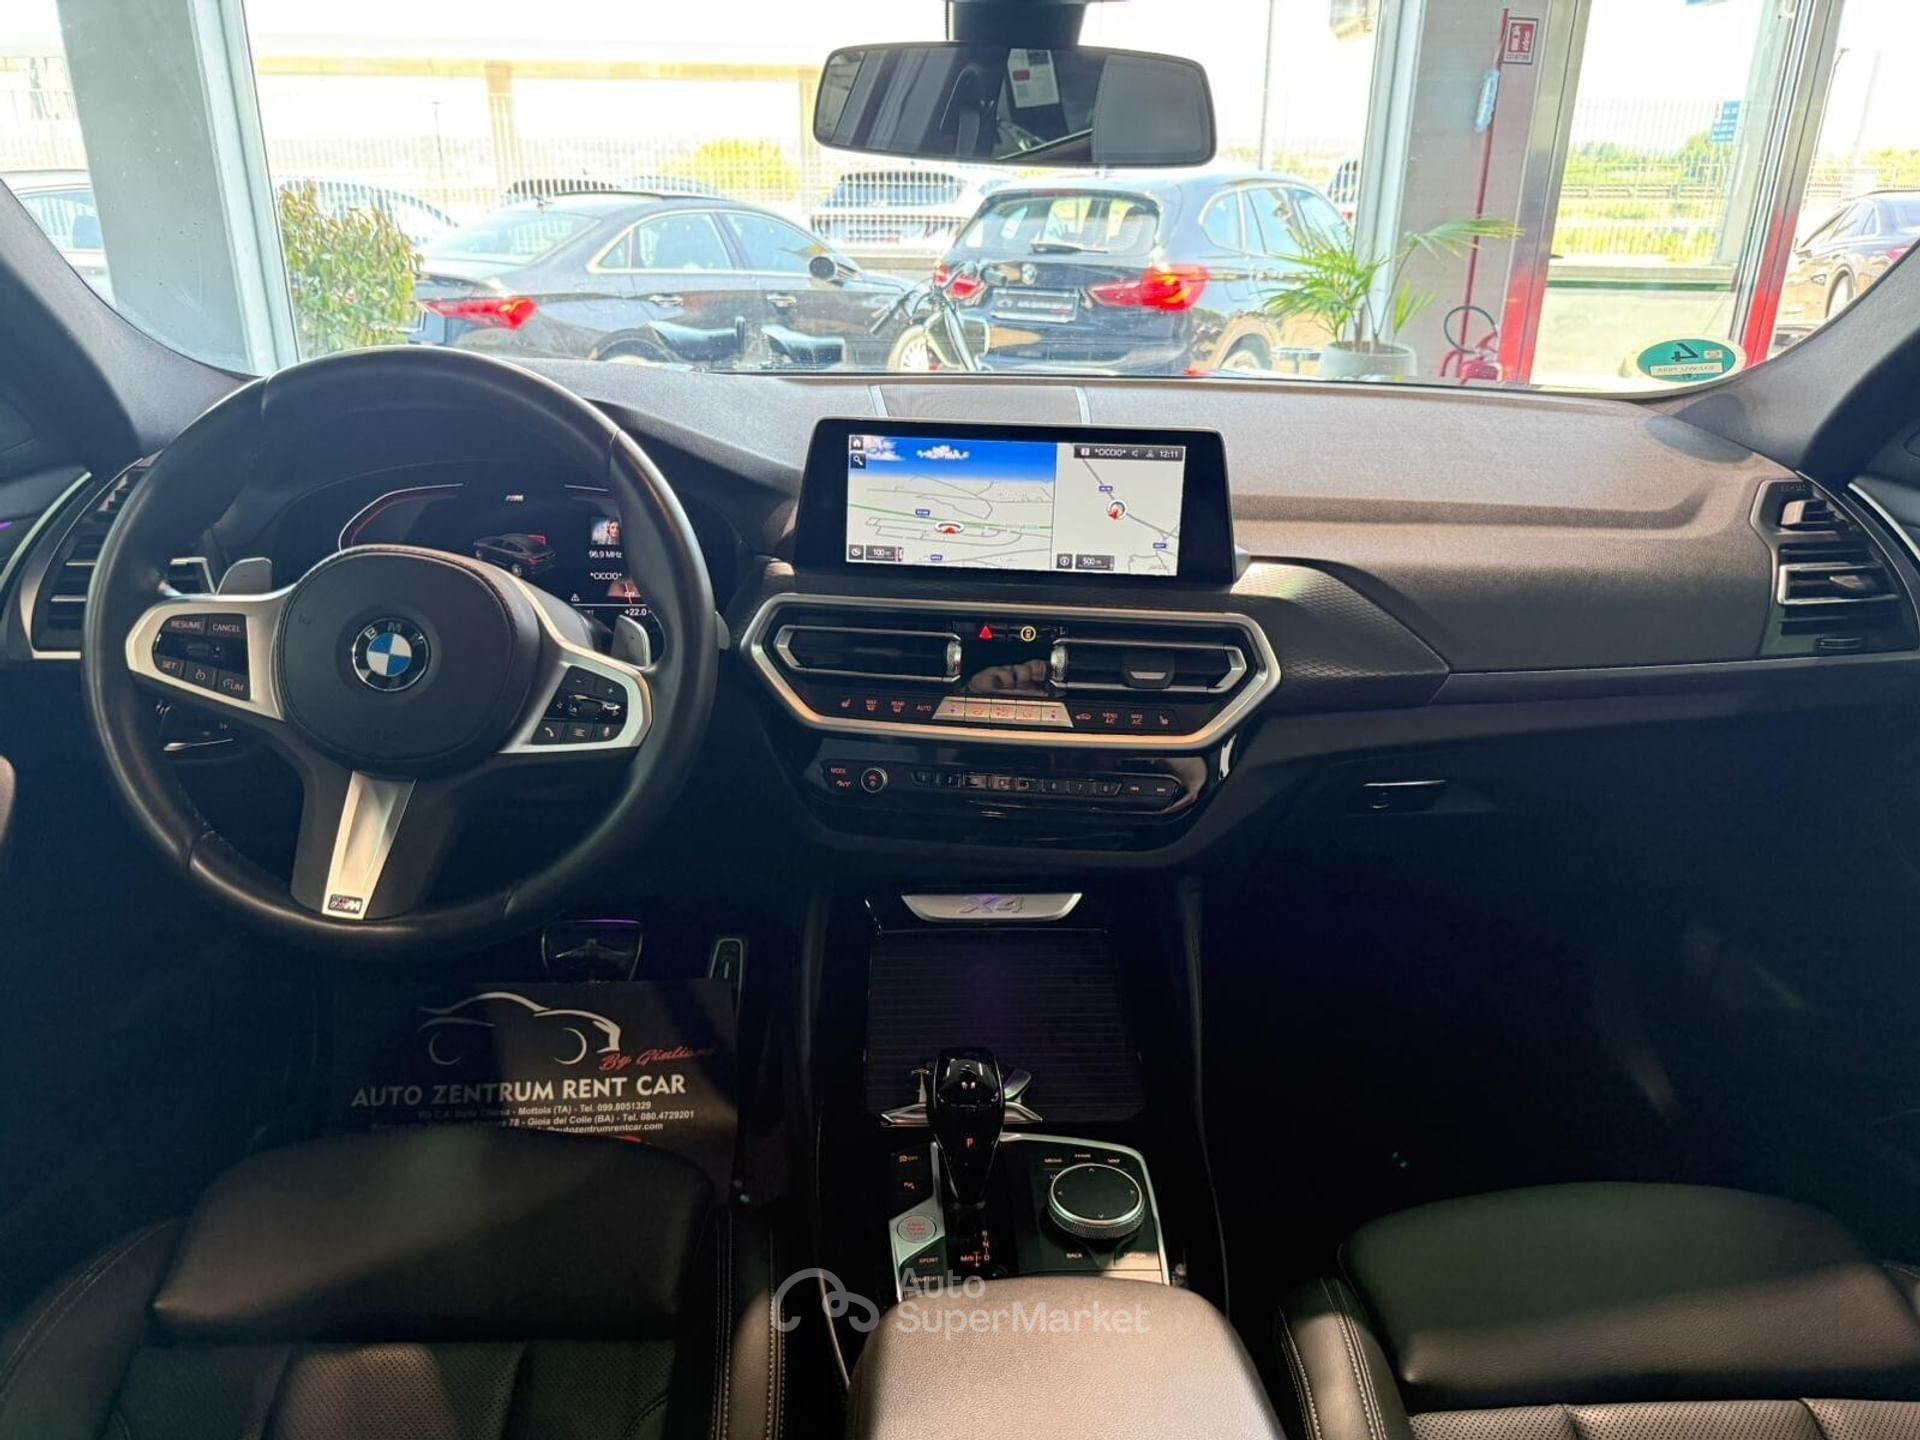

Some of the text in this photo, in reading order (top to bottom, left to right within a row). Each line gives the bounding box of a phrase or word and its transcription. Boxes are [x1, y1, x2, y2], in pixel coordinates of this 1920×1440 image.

[1159, 450, 1179, 459] 12:11
[170, 619, 201, 629] RESUME
[212, 623, 241, 633] CANCEL
[162, 660, 177, 670] SET
[916, 704, 932, 712] AUTO
[959, 896, 1024, 914] X4
[599, 1053, 633, 1071] By
[351, 1074, 686, 1107] AUTO ZENTRUM RENT CAR
[518, 1106, 552, 1116] Mottola
[553, 1104, 572, 1115] (TA)
[553, 1115, 567, 1125] del
[568, 1114, 593, 1124] Colle
[594, 1113, 614, 1124] (BA)
[623, 1112, 639, 1122] Tel.
